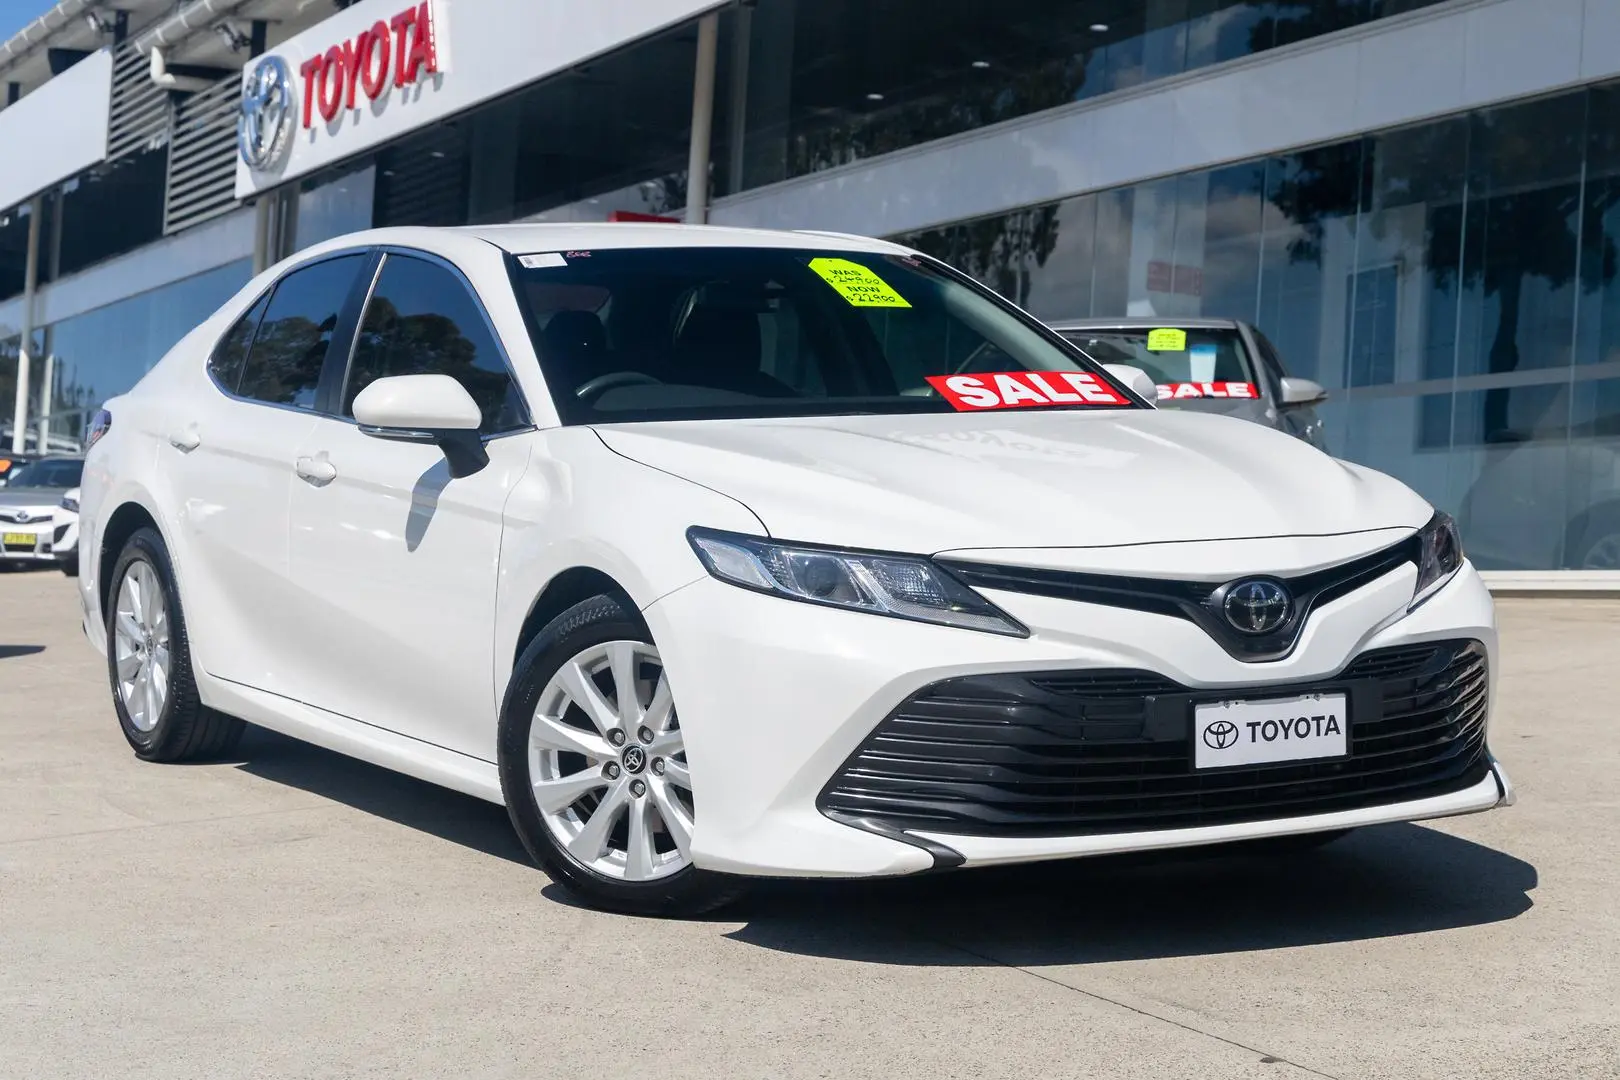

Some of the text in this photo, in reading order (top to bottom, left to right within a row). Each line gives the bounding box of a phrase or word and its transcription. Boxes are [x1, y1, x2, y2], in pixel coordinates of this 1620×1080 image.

[300, 0, 437, 129] TOYOTA
[945, 373, 1117, 407] SALE
[1155, 382, 1252, 400] SALE
[1246, 715, 1341, 743] TOYOTA
